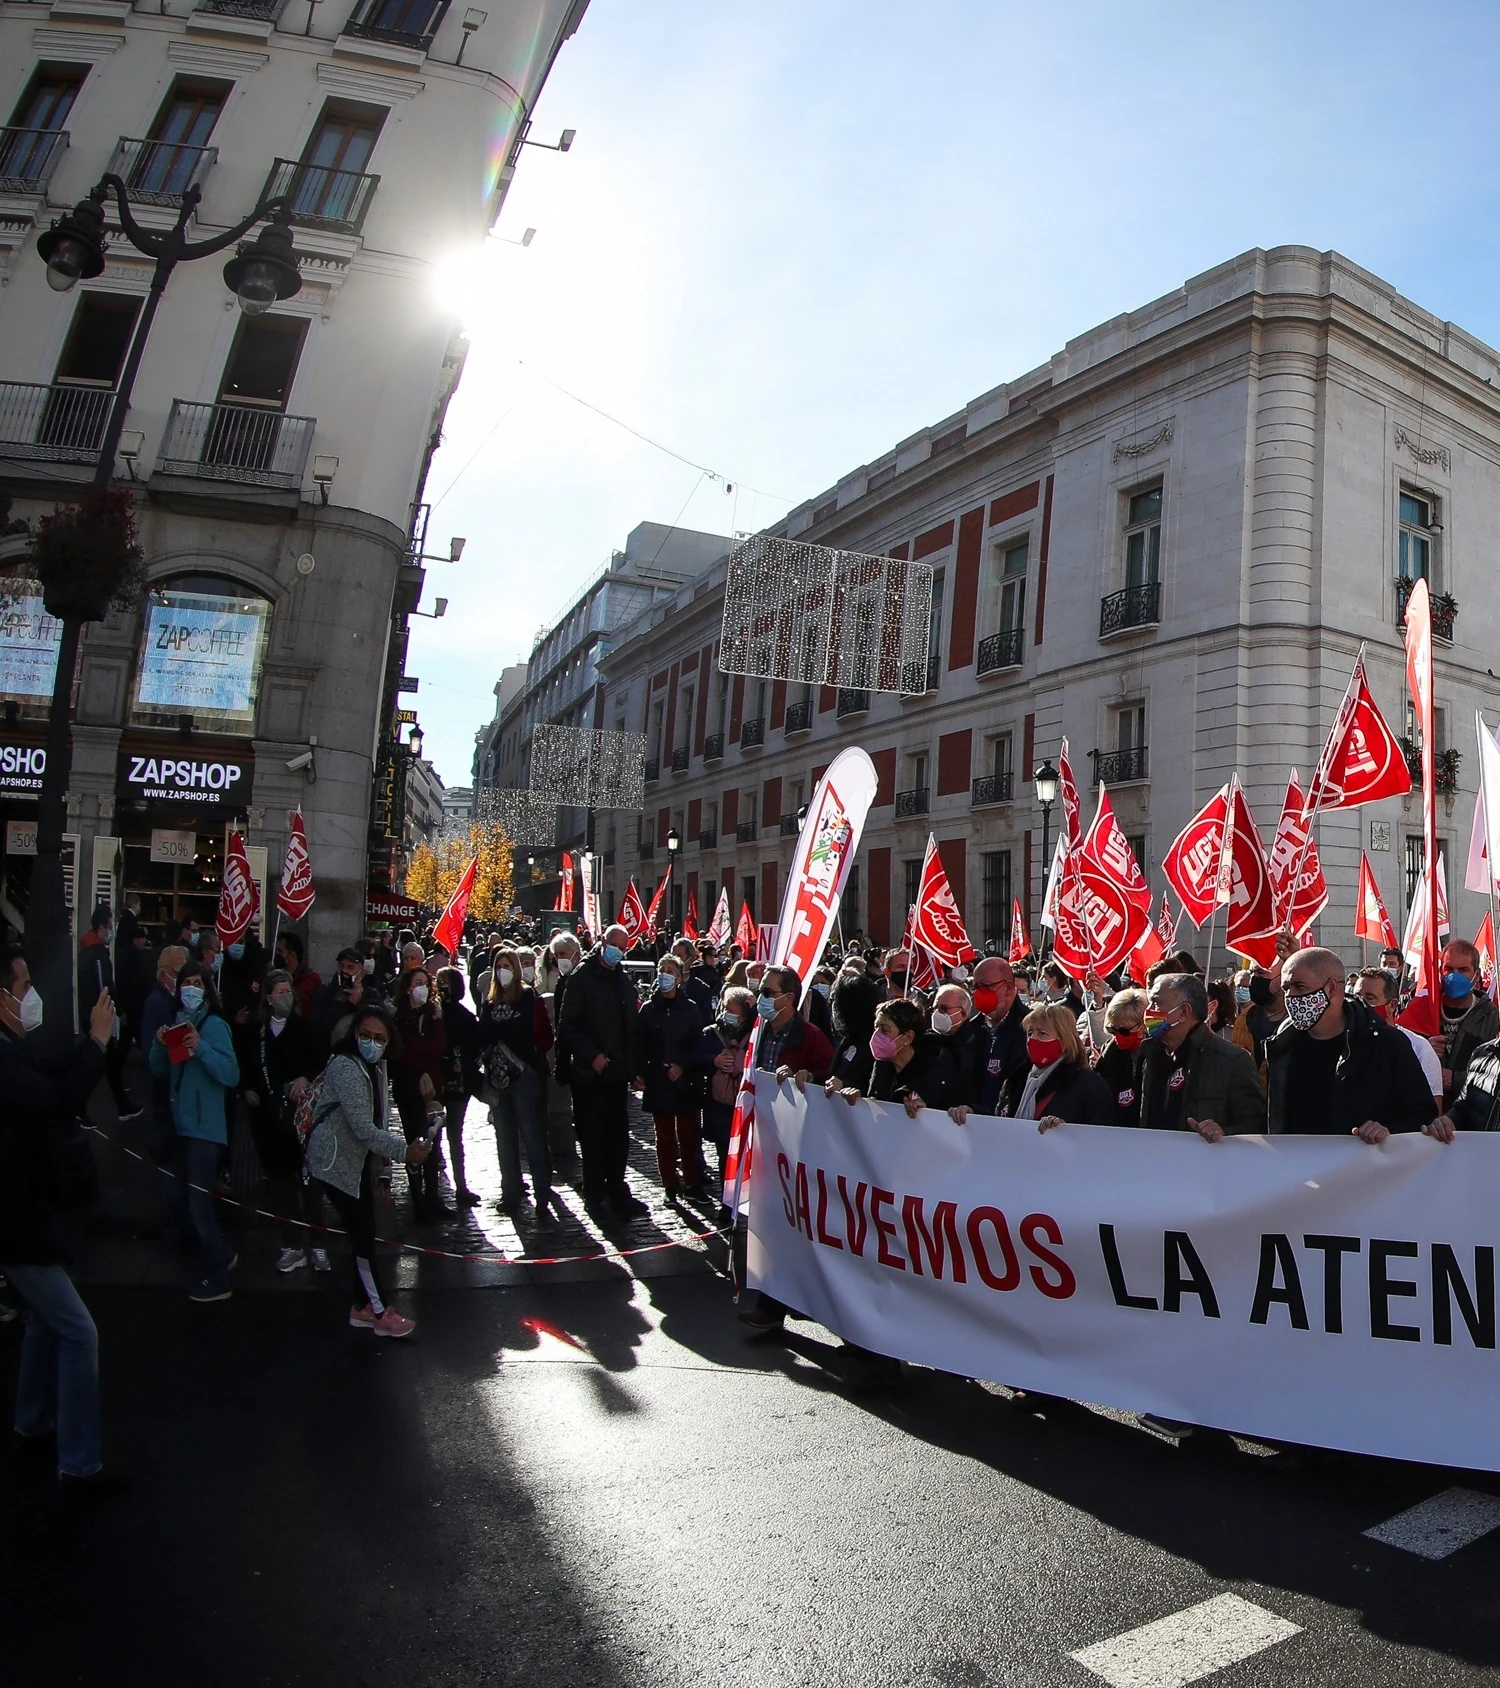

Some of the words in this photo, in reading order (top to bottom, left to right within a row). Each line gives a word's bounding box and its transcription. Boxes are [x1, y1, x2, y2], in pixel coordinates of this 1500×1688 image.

[156, 623, 248, 657] ZAPCOFFEE
[128, 756, 241, 790] ZAPSHOP
[143, 788, 220, 802] WWW.ZAPSHOP.ES
[158, 841, 189, 857] -50%
[1181, 825, 1223, 884] UGT
[224, 860, 251, 919] UGT
[776, 1151, 1078, 1300] SALVEMOS
[1098, 1222, 1222, 1319] LA
